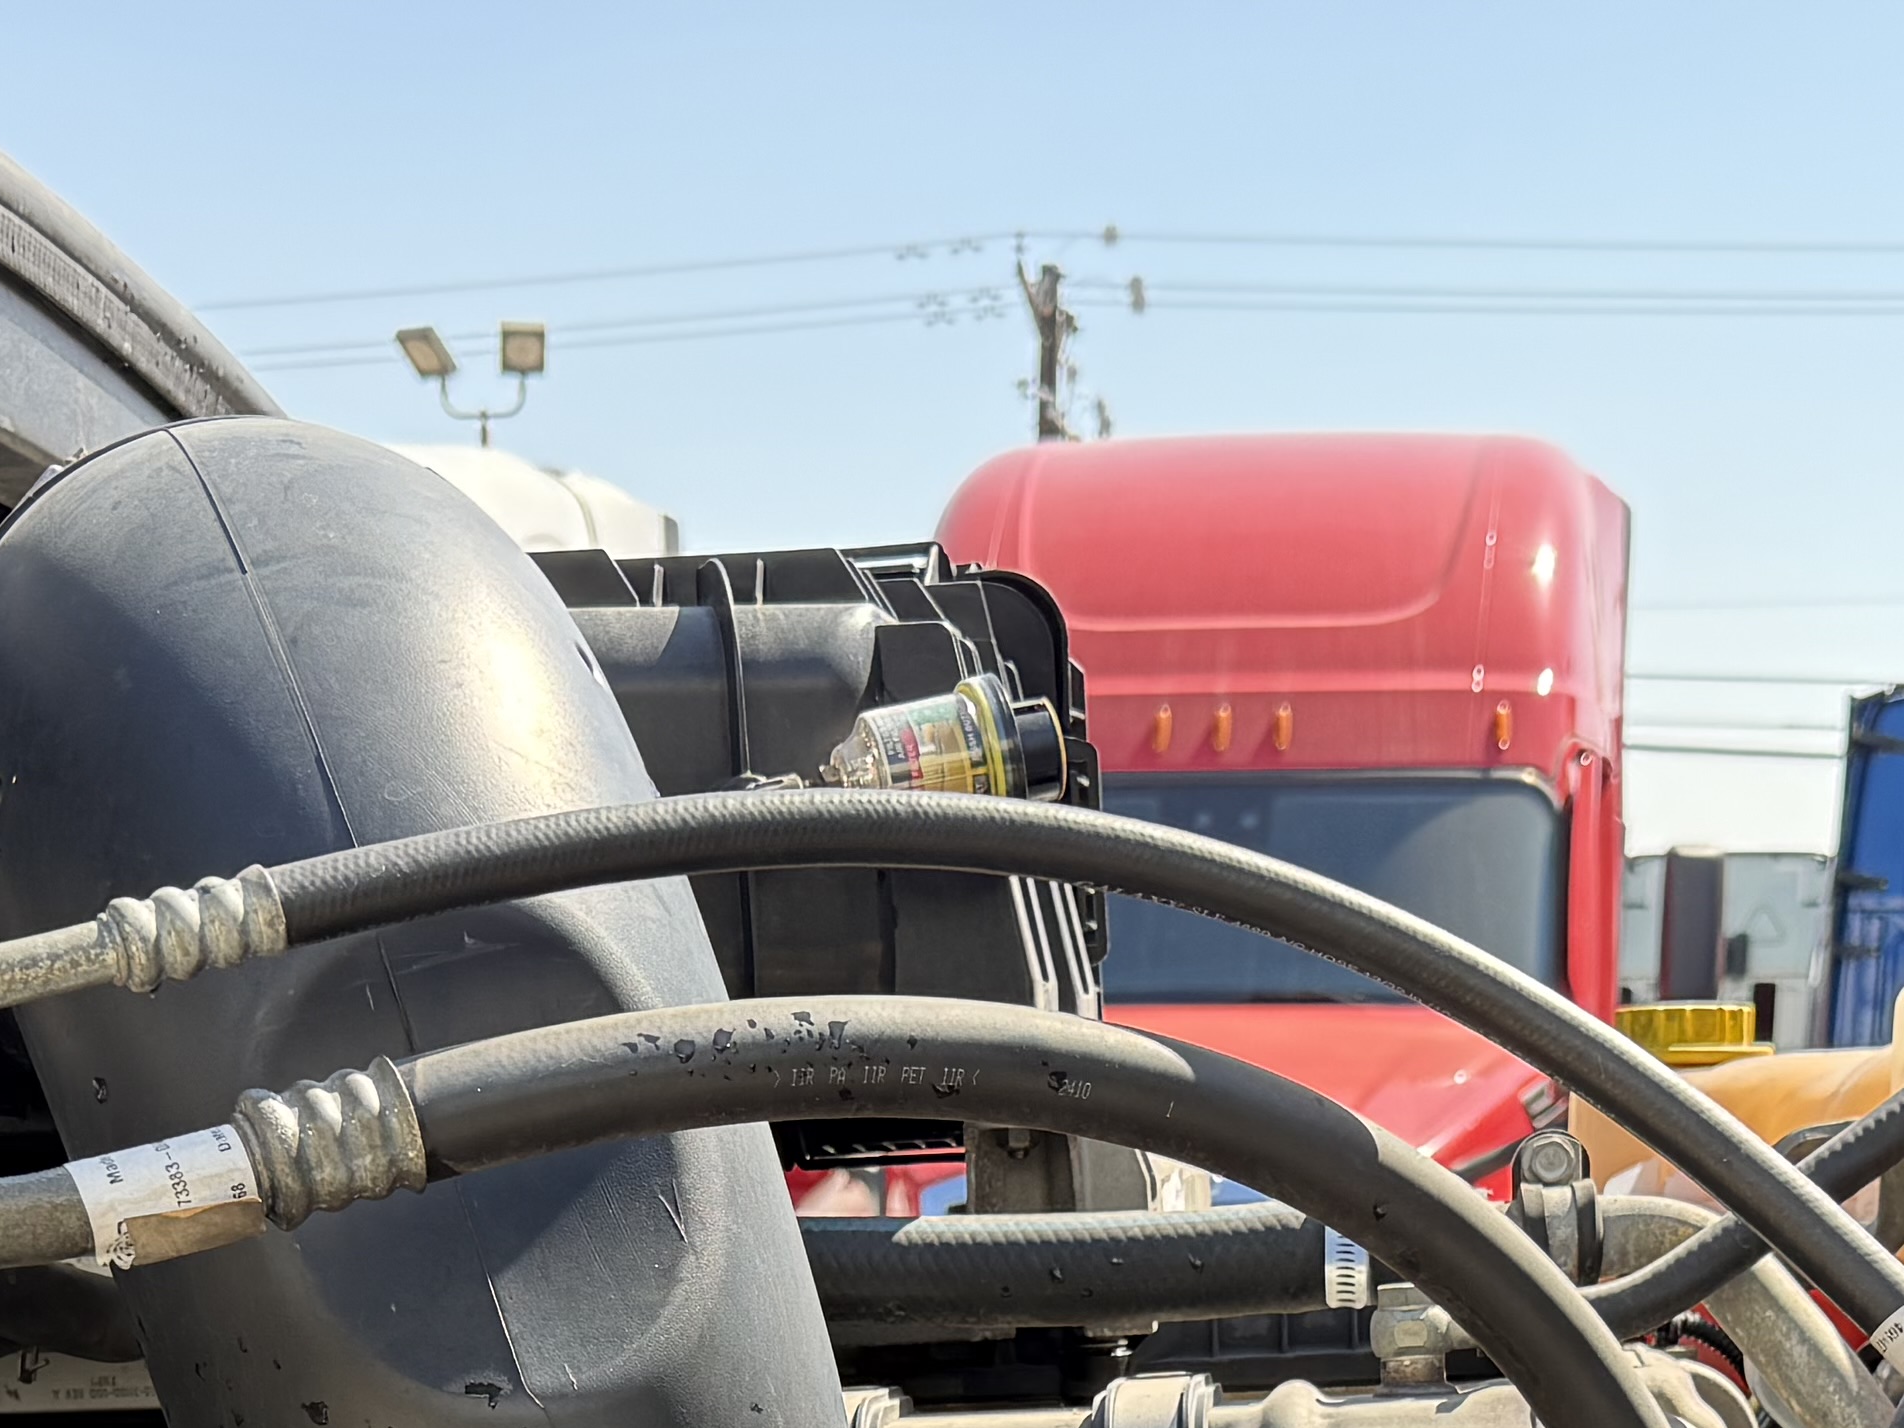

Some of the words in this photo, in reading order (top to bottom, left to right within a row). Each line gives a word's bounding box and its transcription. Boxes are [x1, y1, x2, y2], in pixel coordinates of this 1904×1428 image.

[829, 1068, 846, 1084] PA
[901, 1067, 927, 1084] PET
[1059, 1080, 1092, 1100] 2410
